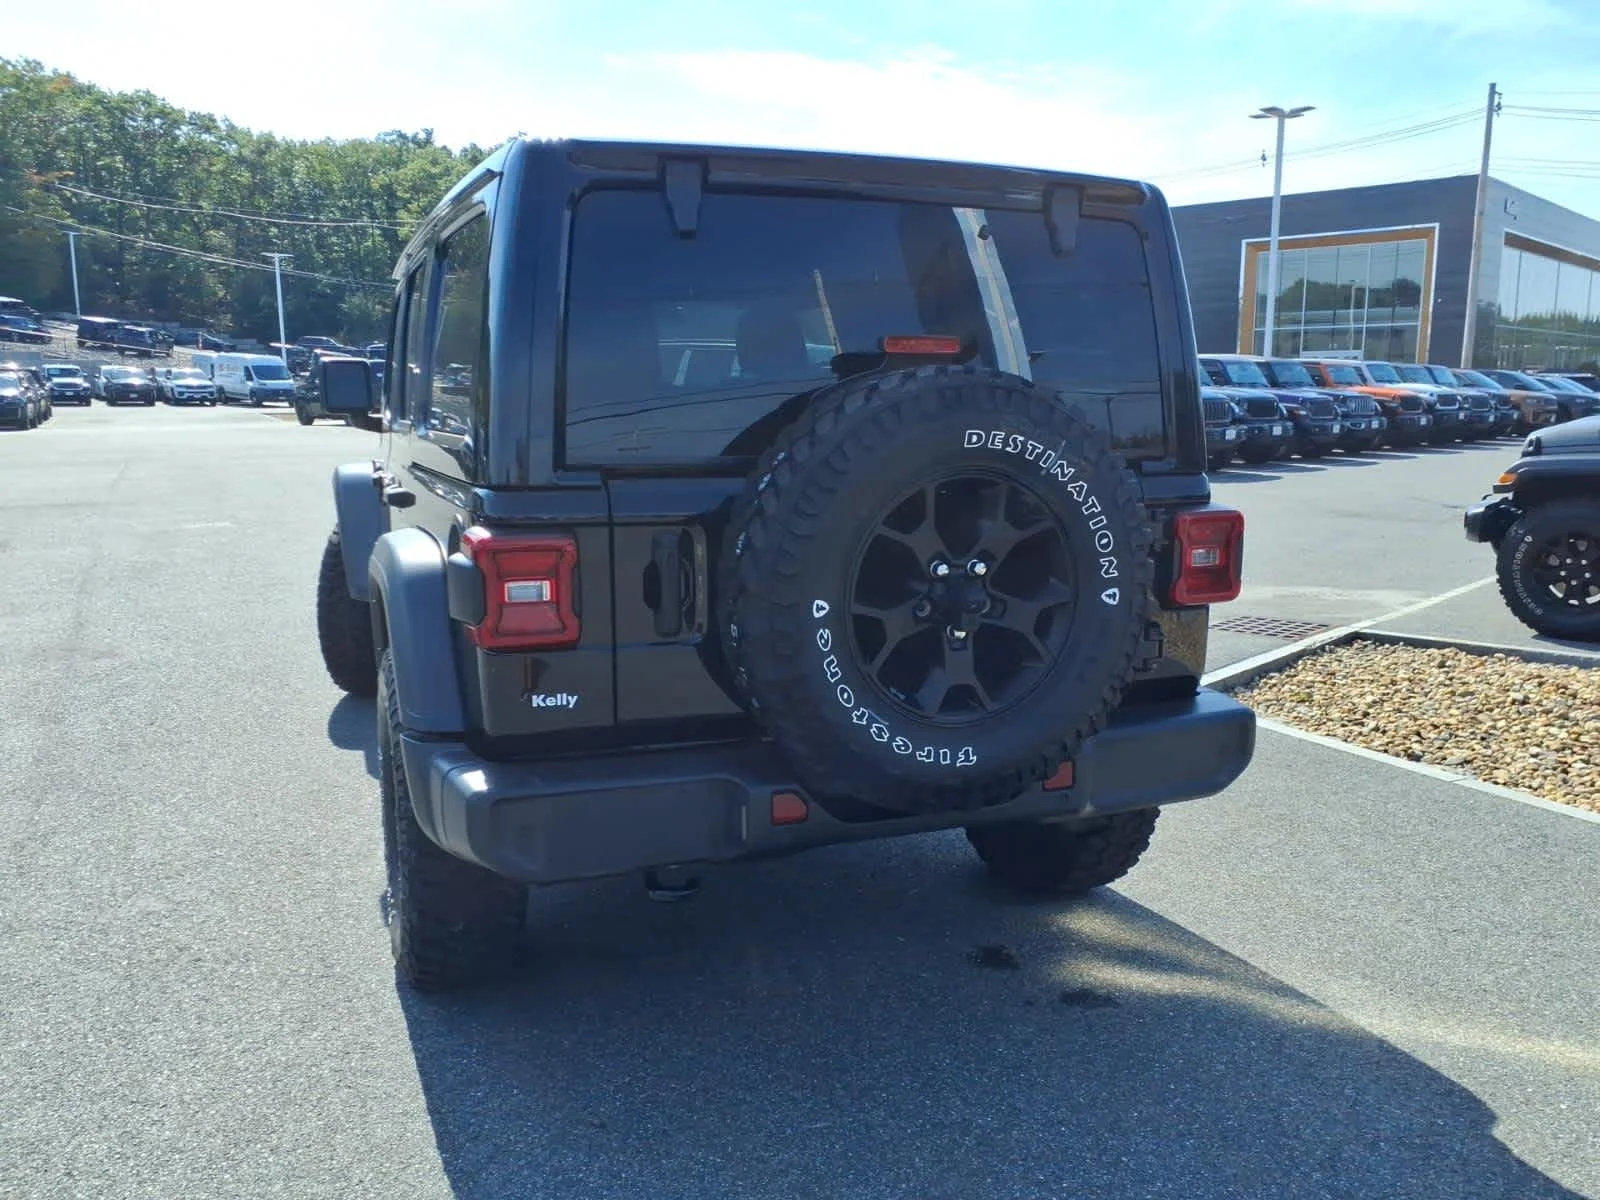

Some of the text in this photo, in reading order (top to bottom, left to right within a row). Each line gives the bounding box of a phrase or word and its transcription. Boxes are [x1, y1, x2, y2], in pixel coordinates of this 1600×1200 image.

[964, 430, 1119, 578] DESTINATION
[531, 693, 578, 708] Kelly
[816, 627, 977, 767] Firestone
